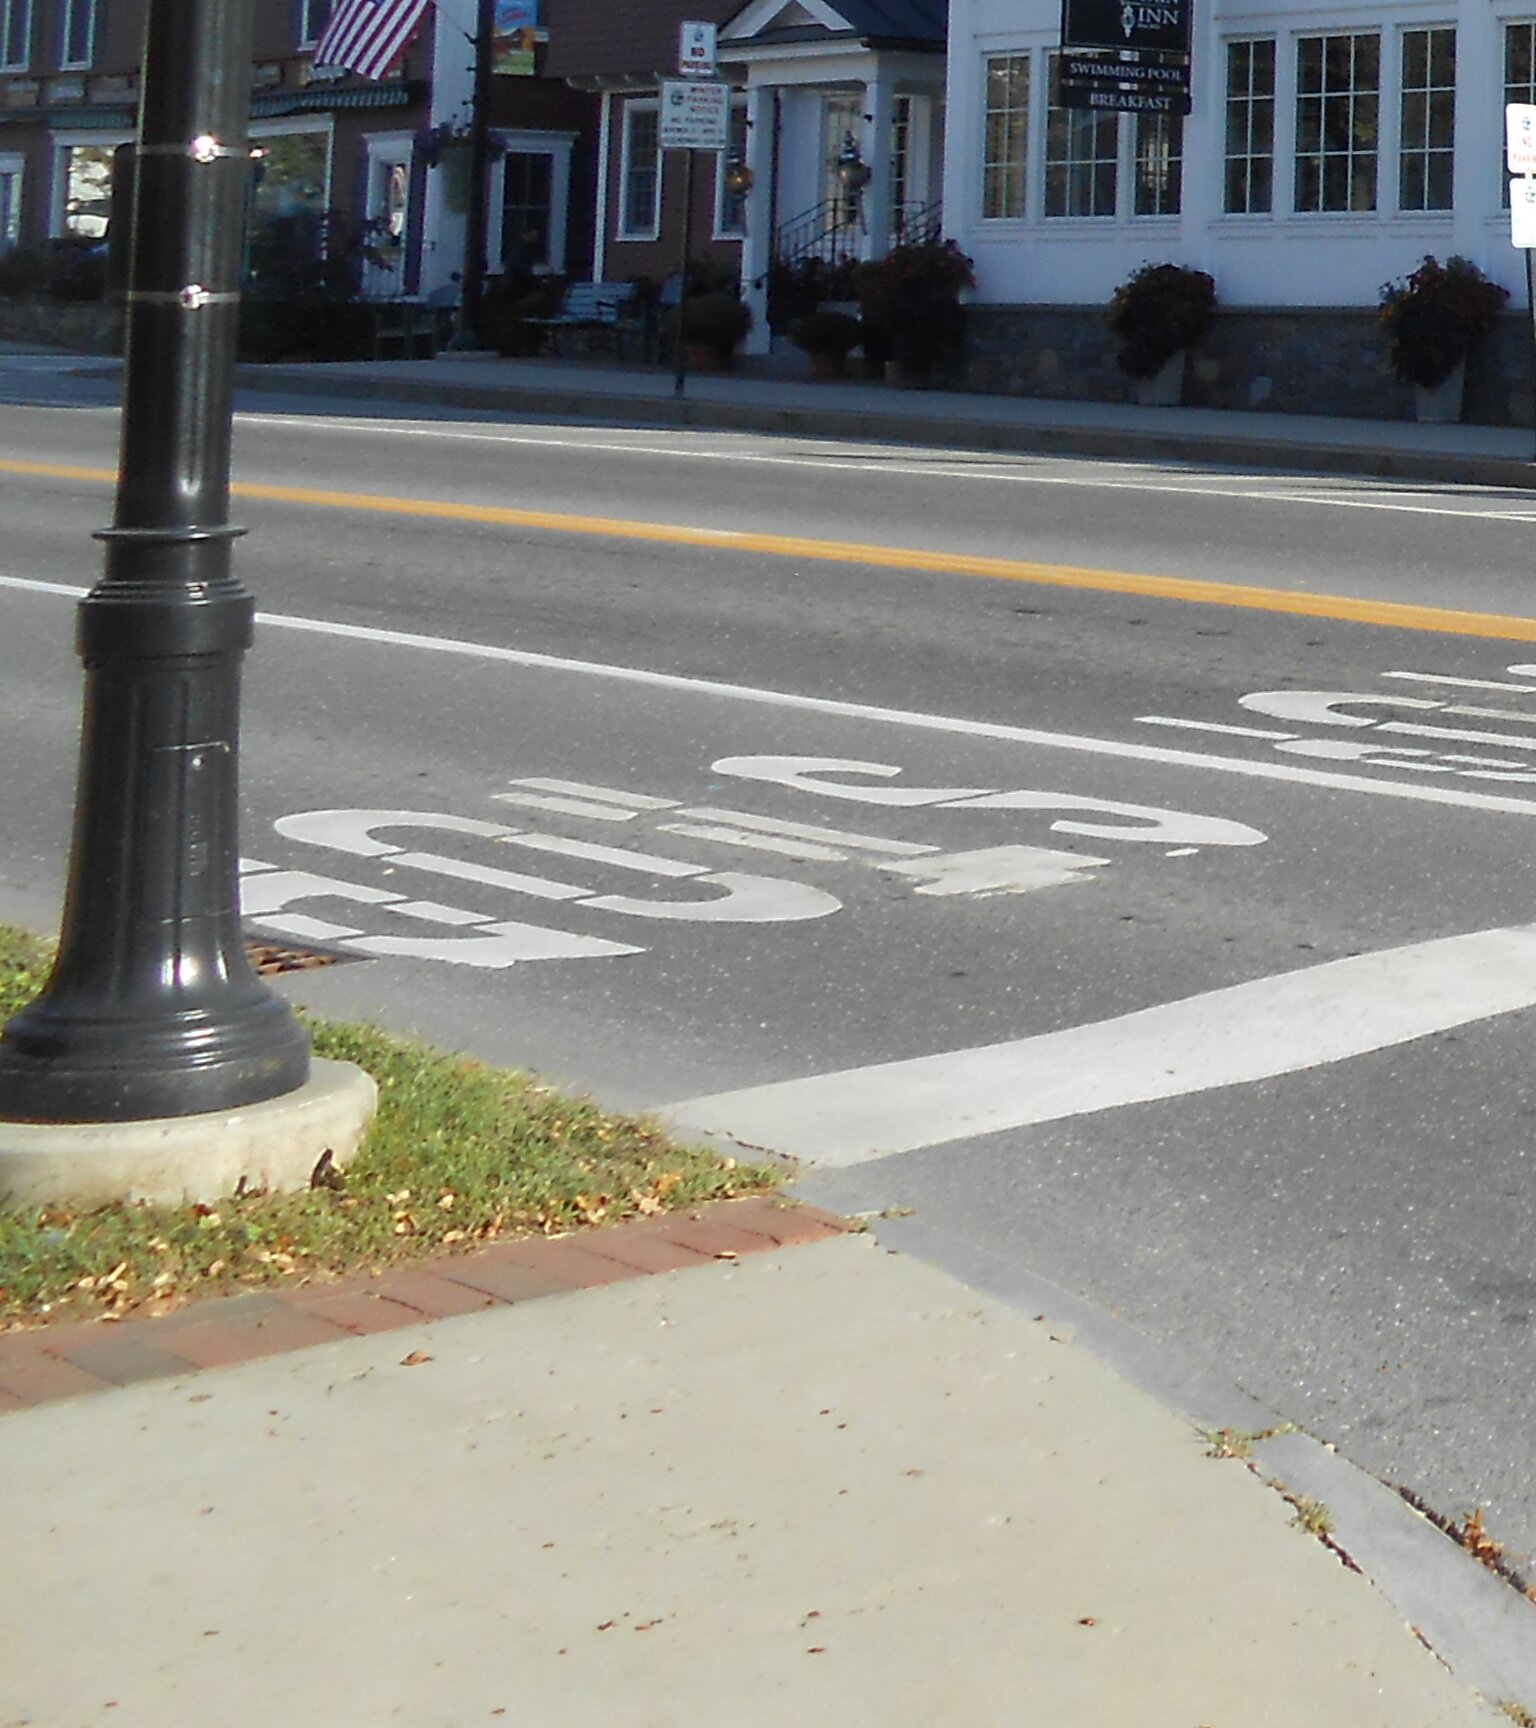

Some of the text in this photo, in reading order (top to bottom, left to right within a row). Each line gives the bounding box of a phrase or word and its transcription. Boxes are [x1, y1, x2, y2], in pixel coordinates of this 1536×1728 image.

[1138, 7, 1179, 25] INN
[1069, 62, 1183, 81] SWIMMING POOL
[1089, 92, 1172, 110] BREAKFAST
